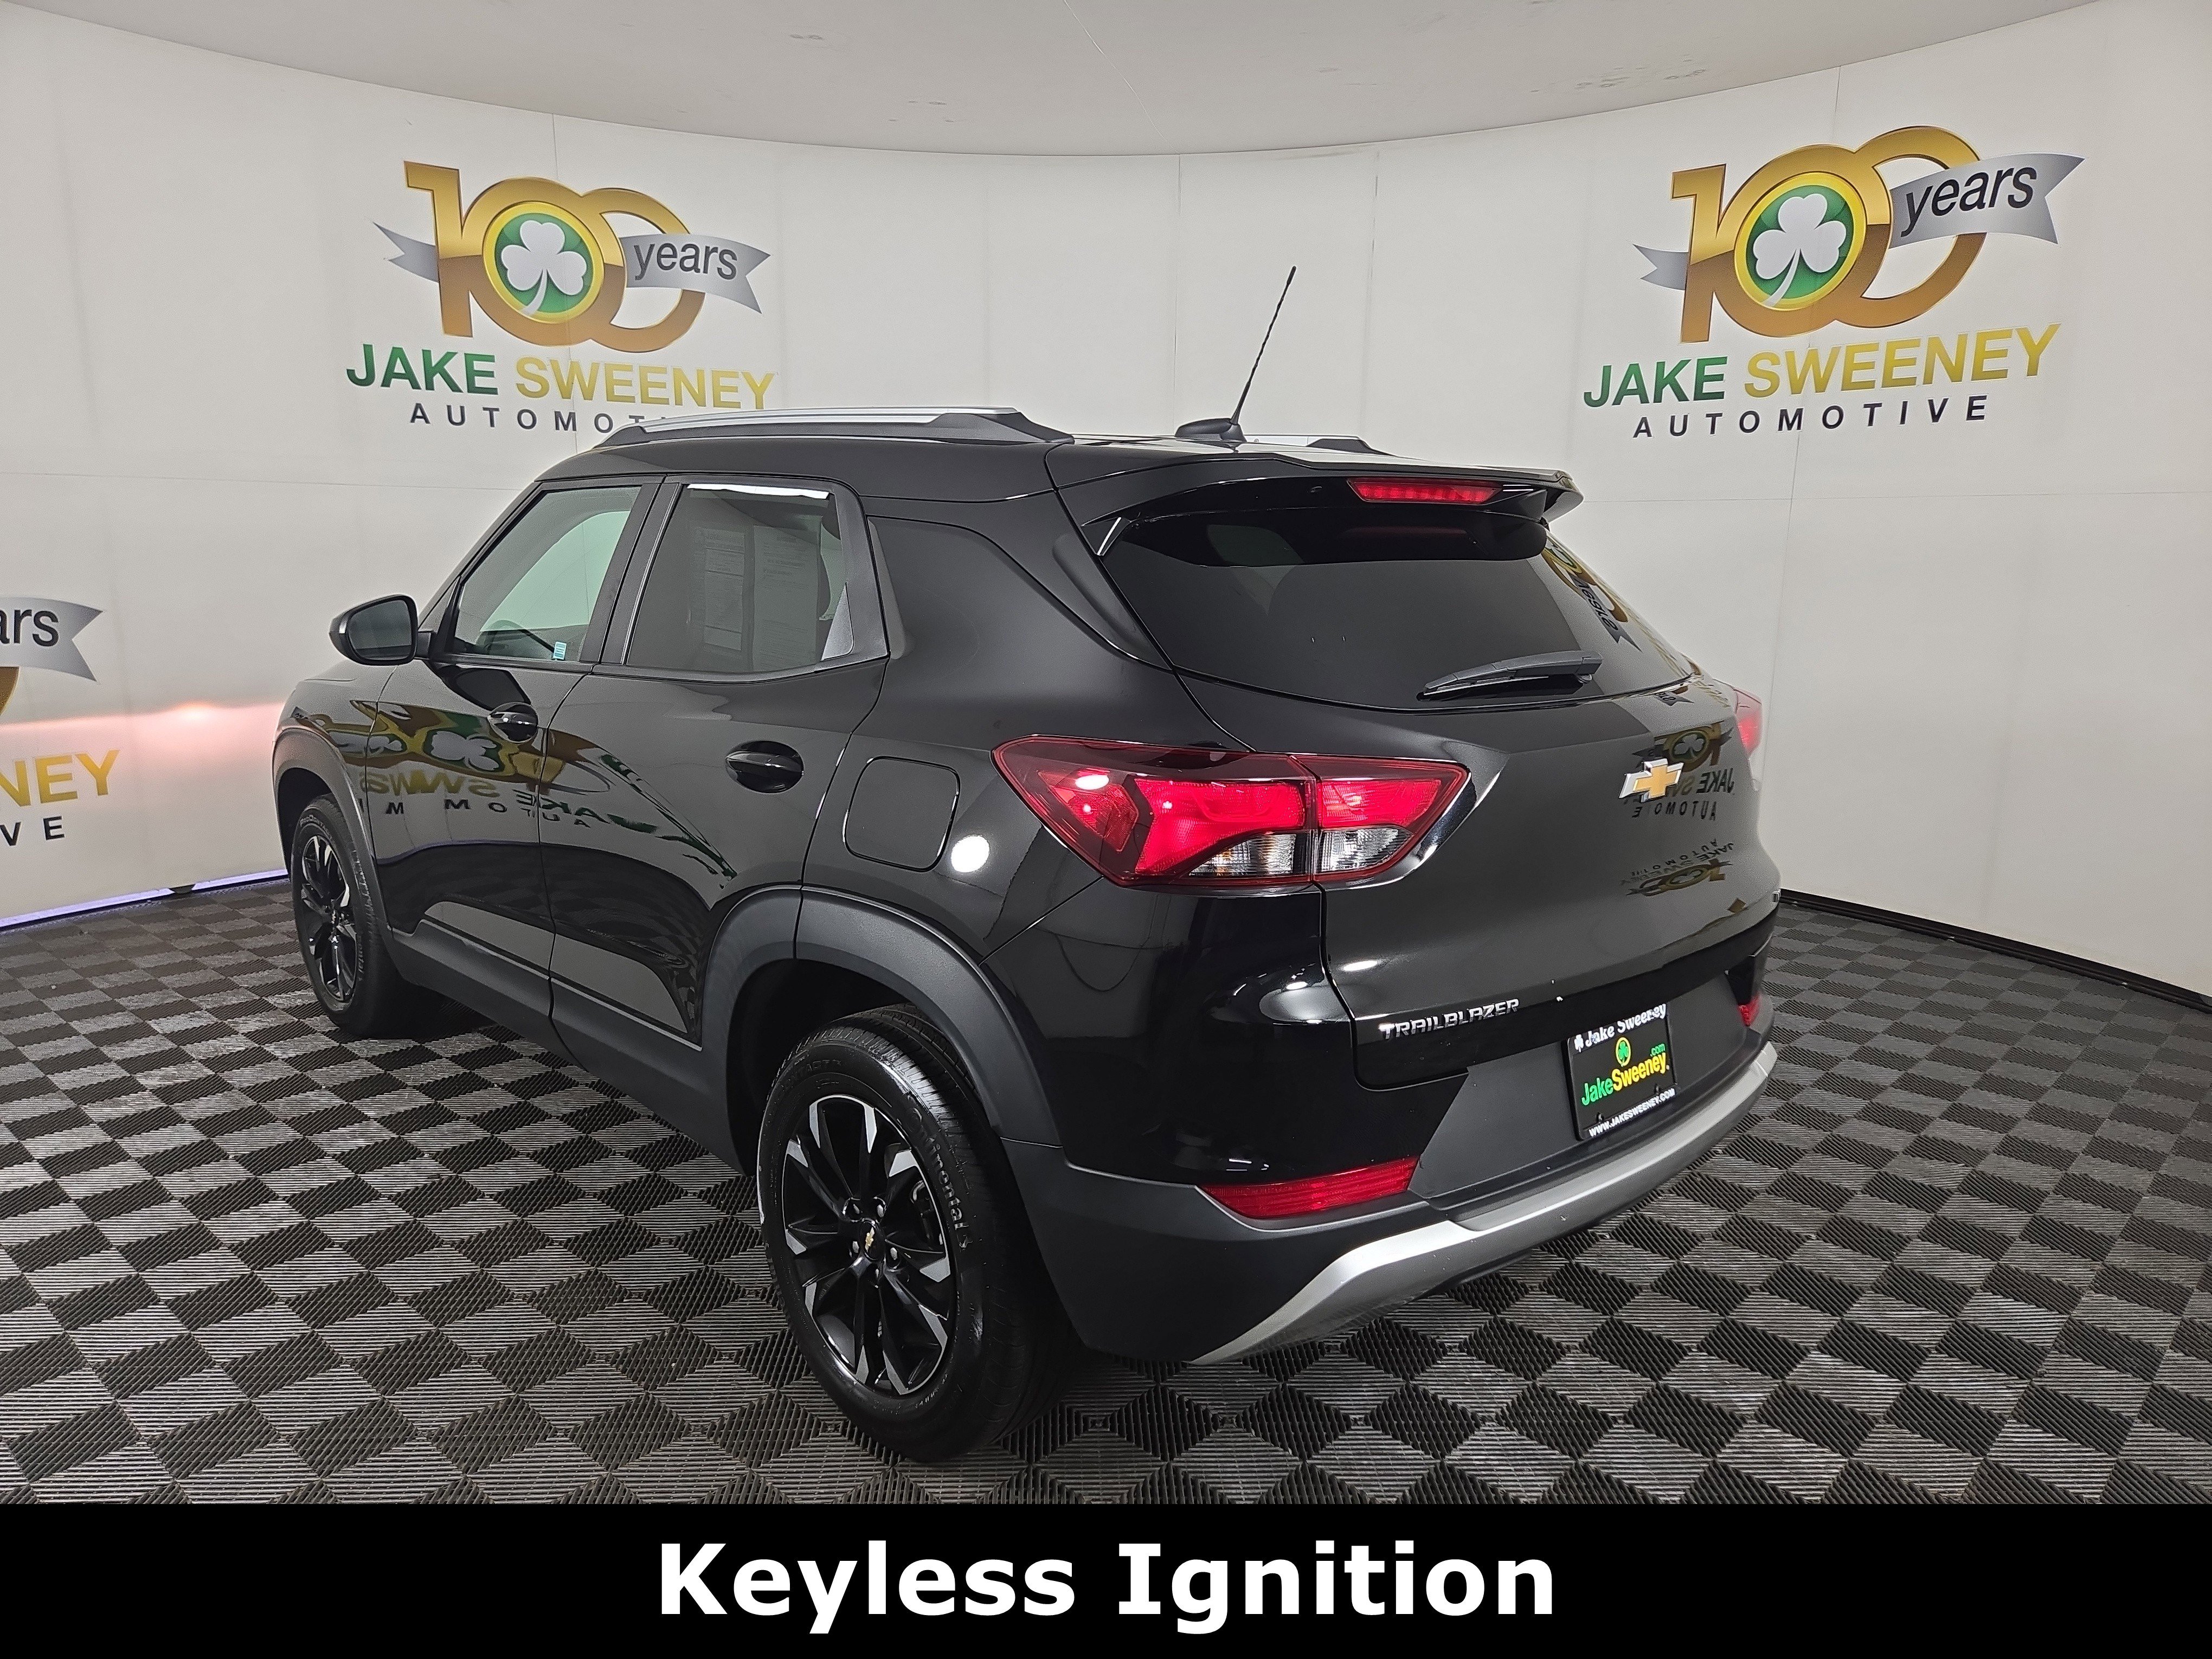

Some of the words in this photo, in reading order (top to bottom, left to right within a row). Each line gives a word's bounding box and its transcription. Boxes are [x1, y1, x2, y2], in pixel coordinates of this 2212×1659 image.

[403, 160, 705, 353] 100
[633, 239, 738, 280] years
[1672, 125, 1988, 343] 100
[1900, 165, 2037, 239] years
[346, 343, 498, 395] JAKE
[515, 356, 775, 409] SWEENEY
[1584, 356, 1727, 407] JAKE
[1744, 323, 2062, 397] SWEENEY
[1632, 395, 1989, 438] AUTOMOTIVE
[1379, 998, 1519, 1039] TRAILBLAZER
[1585, 1025, 1615, 1047] Jake
[1589, 1088, 1675, 1137] WWW.JAKESWEENEY.COM
